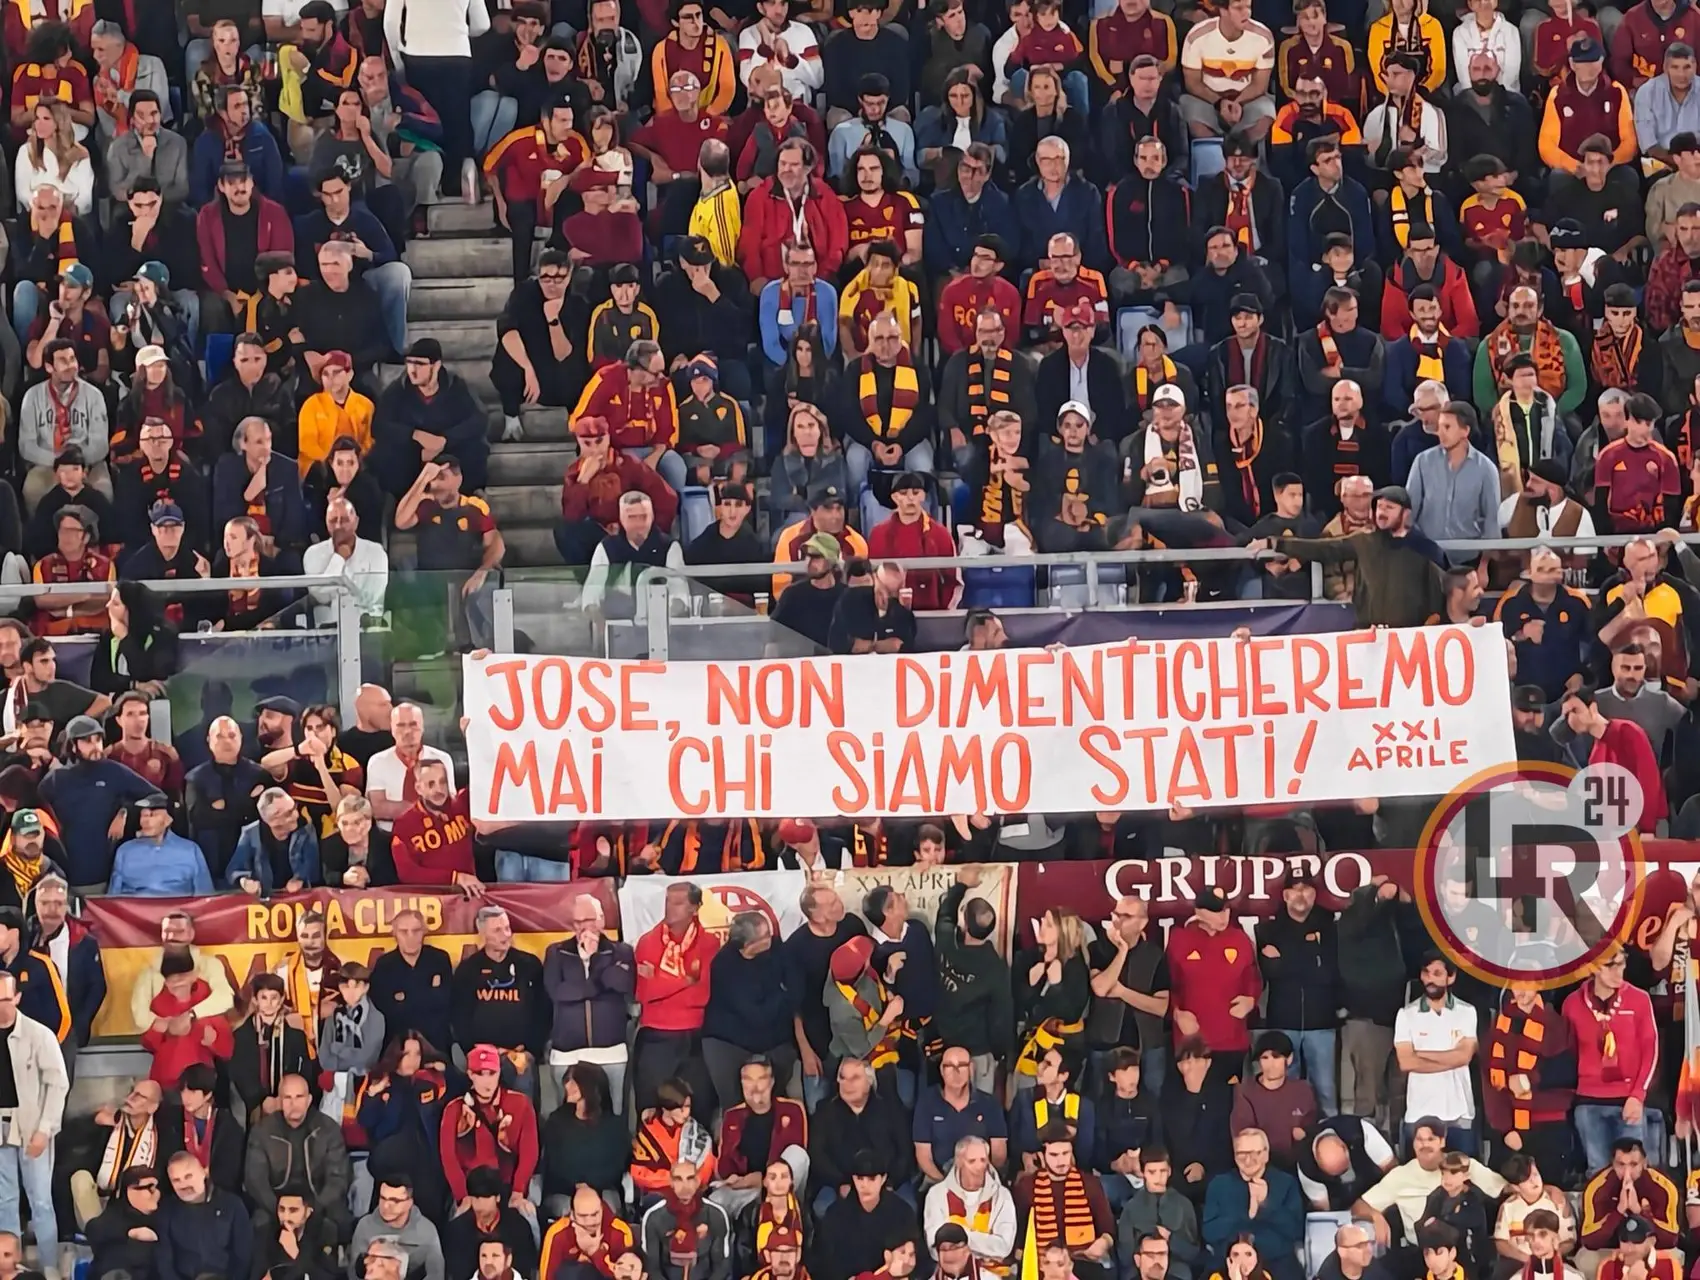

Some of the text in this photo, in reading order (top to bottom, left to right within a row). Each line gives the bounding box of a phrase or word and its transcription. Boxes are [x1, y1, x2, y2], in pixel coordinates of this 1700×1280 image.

[706, 658, 845, 730] NON
[1373, 717, 1441, 747] XXI
[1347, 735, 1469, 771] APRILE
